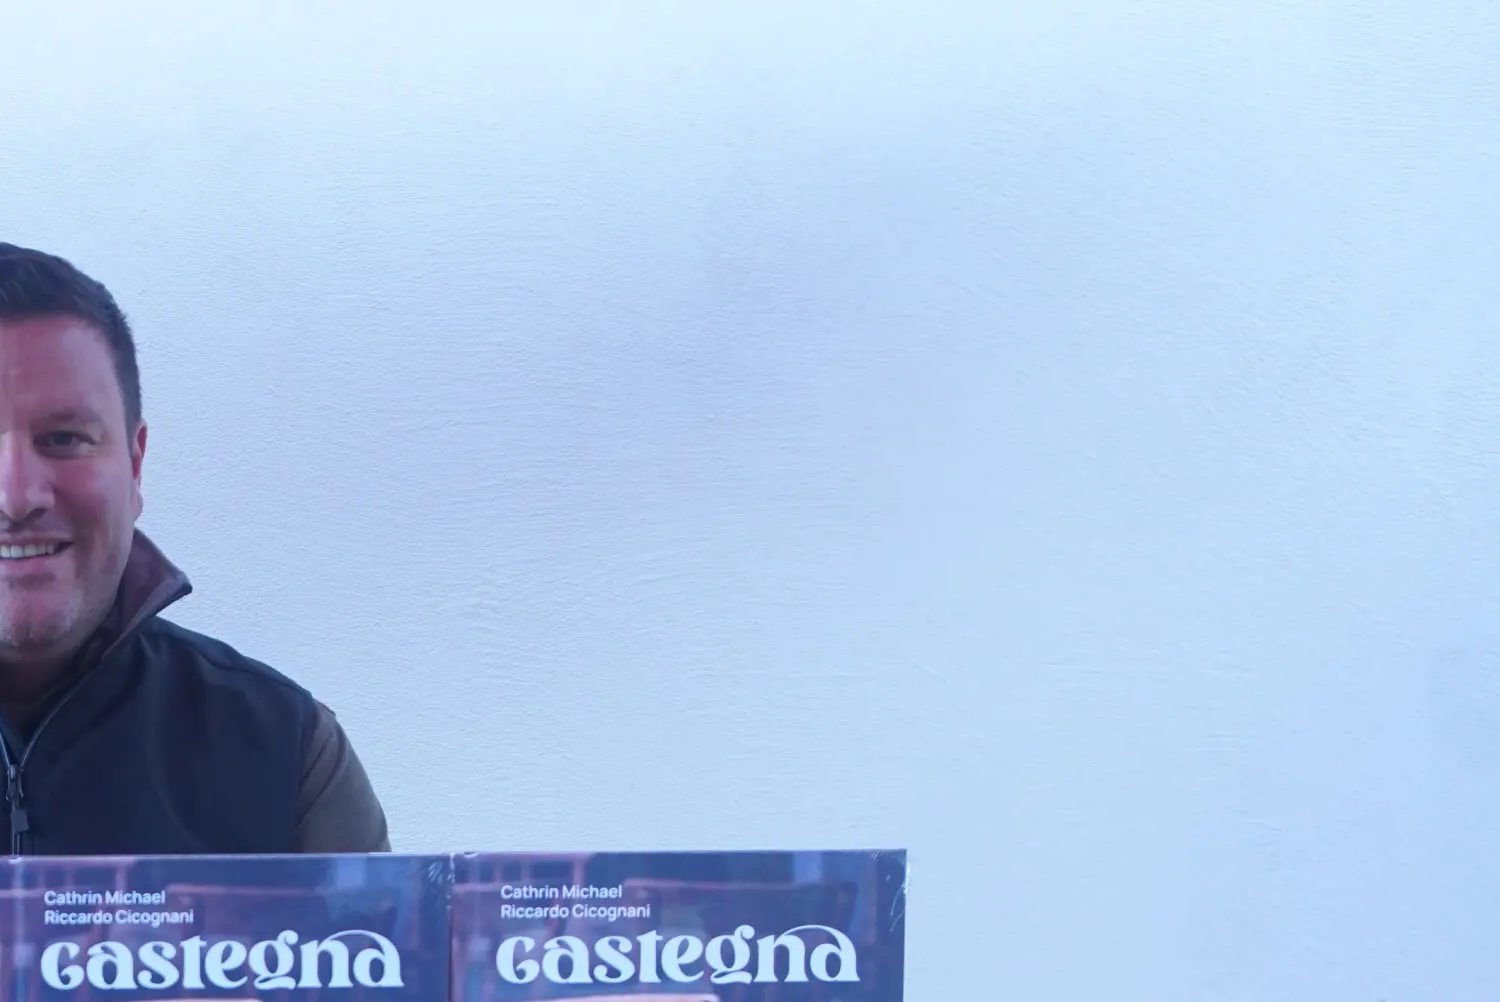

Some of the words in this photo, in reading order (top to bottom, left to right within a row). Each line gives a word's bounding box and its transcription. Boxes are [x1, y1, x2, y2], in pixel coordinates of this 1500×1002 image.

[44, 891, 102, 905] Cathrin
[105, 891, 165, 905] Michael
[500, 885, 558, 899] Cathrin
[562, 885, 622, 899] Michael
[44, 910, 112, 925] Riccardo
[115, 910, 194, 927] Cicognani
[500, 904, 569, 918] Riccardo
[572, 904, 650, 922] Cicognani
